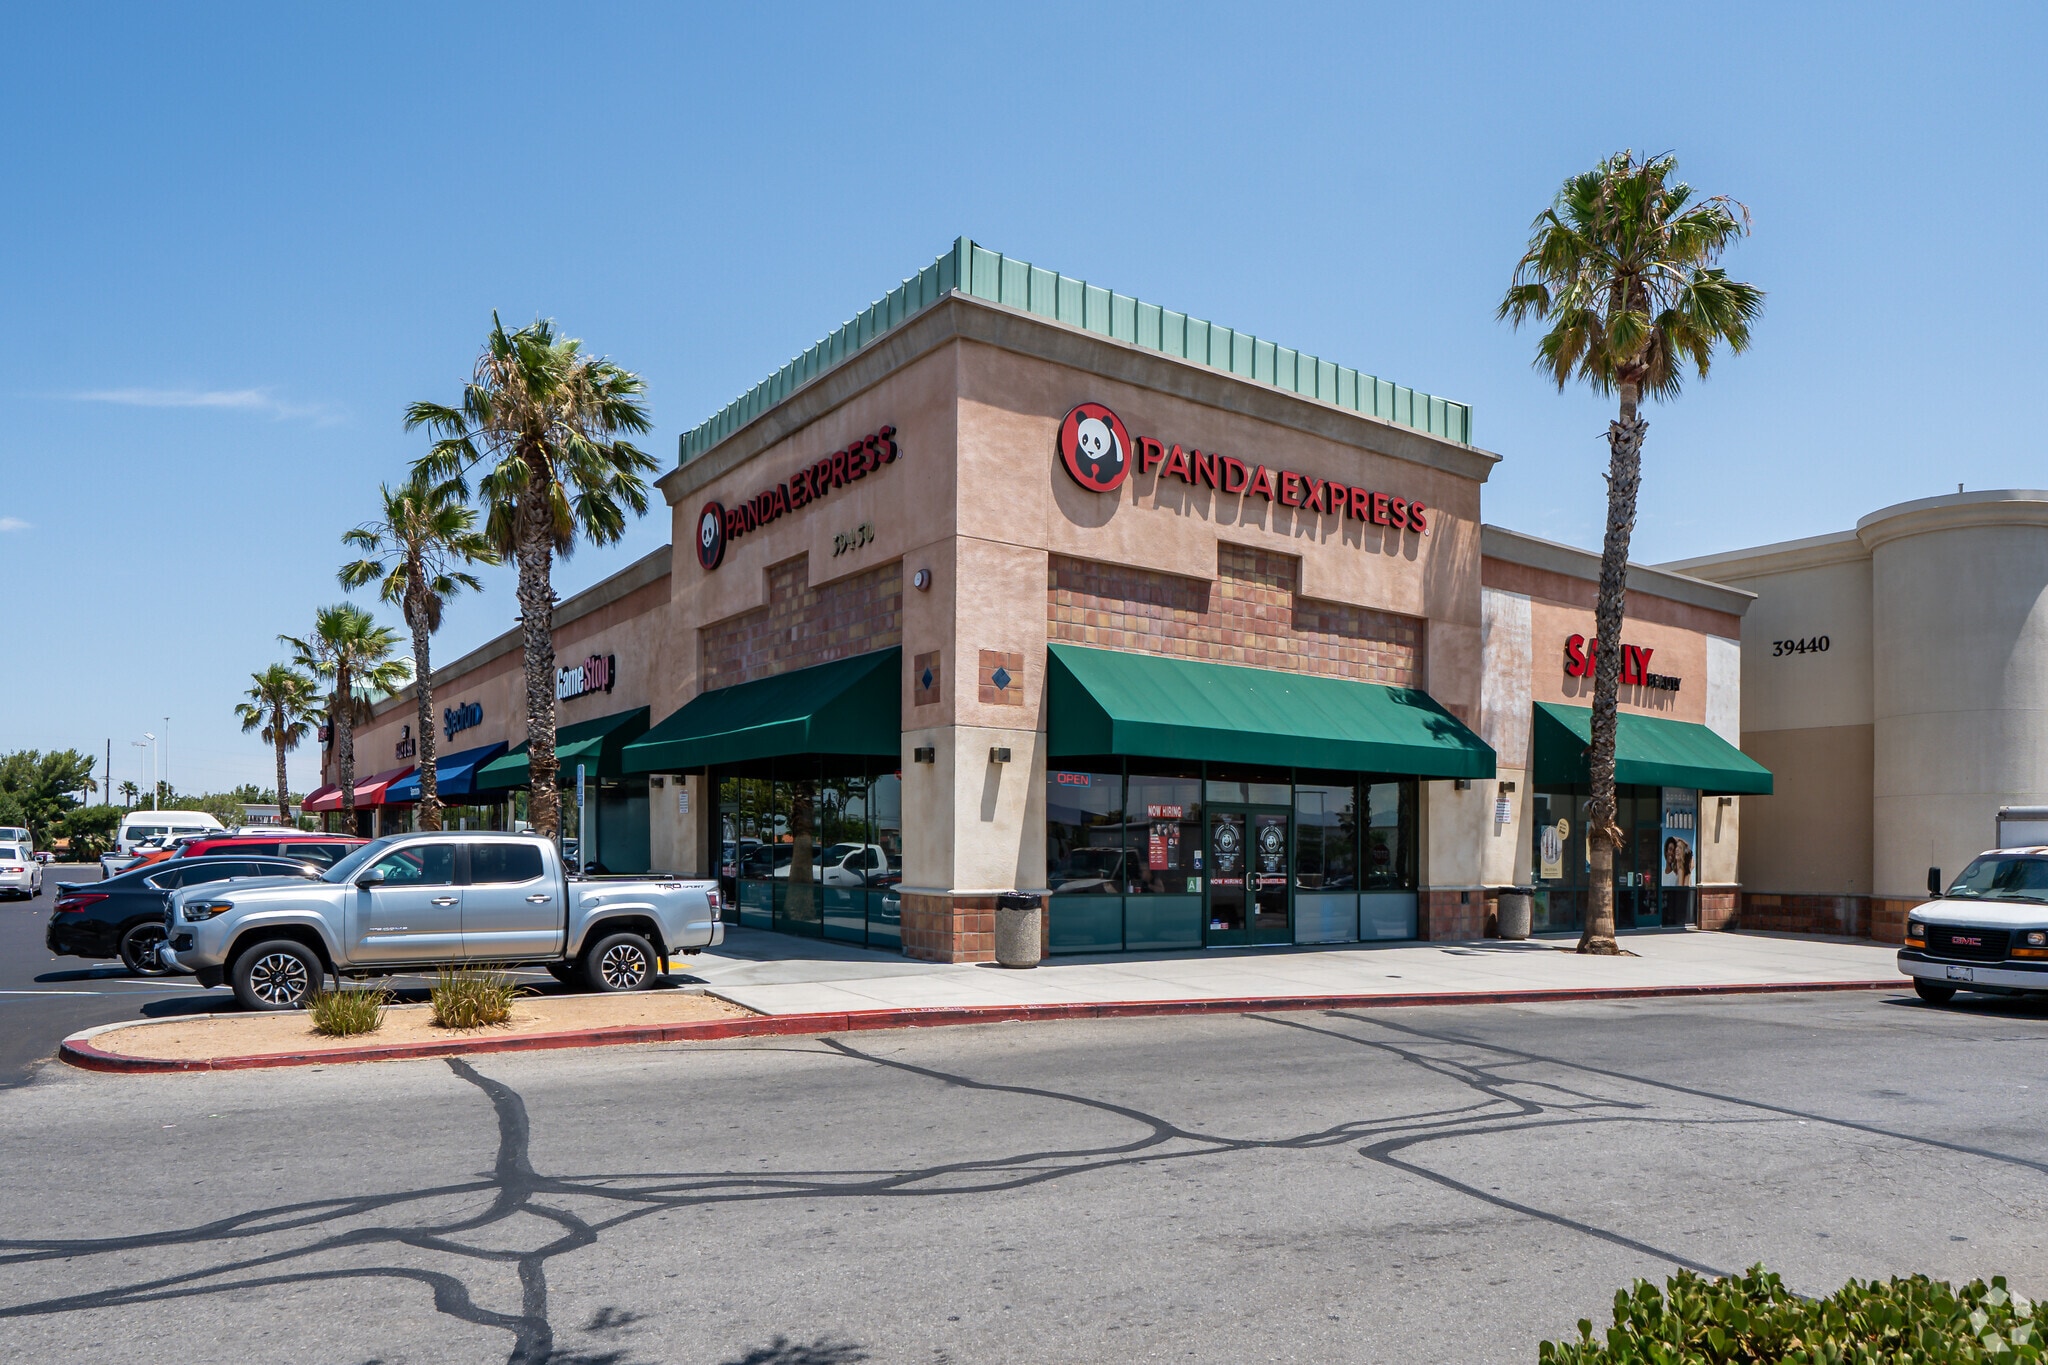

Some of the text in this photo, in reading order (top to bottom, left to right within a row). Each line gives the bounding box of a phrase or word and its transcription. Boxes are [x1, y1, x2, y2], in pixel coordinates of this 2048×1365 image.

[726, 425, 897, 541] PANDA EXPRESS
[1135, 436, 1427, 533] PANDA EXPRESS
[832, 521, 875, 557] 39450
[1772, 635, 1830, 657] 39440
[1565, 634, 1682, 691] SLY BEAUTY
[556, 655, 611, 700] GameStop
[1057, 773, 1089, 785] OPEN
[1148, 805, 1182, 818] NOW HIRING
[1188, 880, 1195, 890] A
[1951, 936, 1982, 946] GMC
